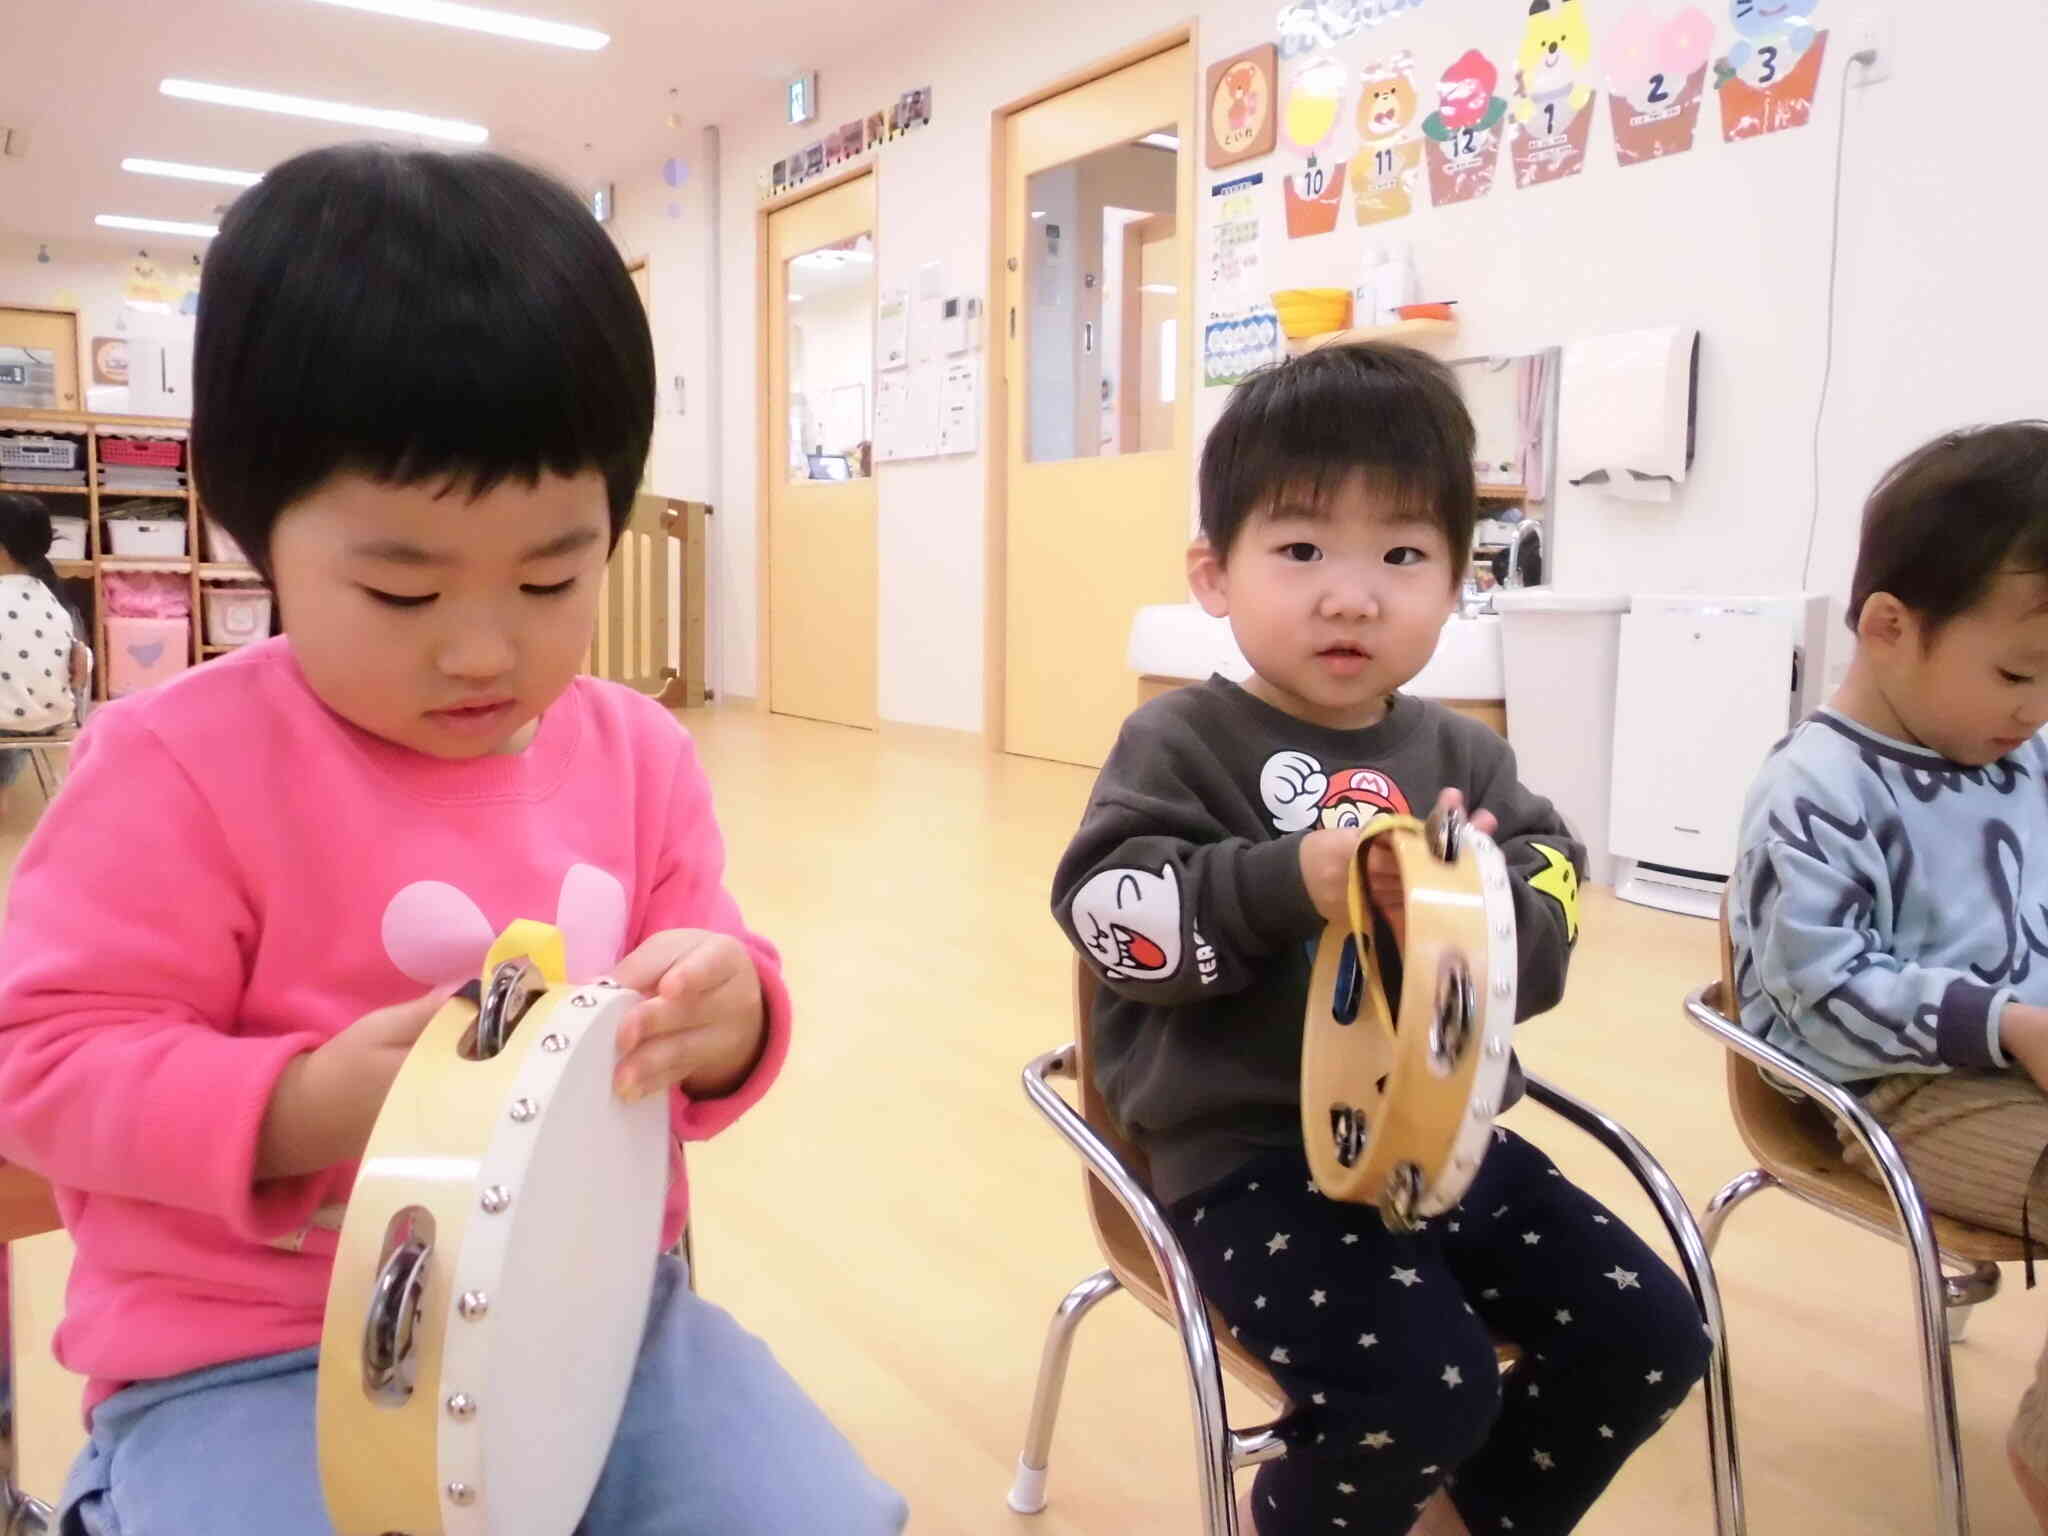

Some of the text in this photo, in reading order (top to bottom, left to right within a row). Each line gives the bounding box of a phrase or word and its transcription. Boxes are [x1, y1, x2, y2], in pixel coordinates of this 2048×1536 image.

[1757, 45, 1778, 84] 3
[1647, 73, 1669, 104] 2
[1543, 102, 1555, 135] 1
[1452, 128, 1477, 158] 12
[1375, 148, 1393, 176] 11
[1304, 168, 1324, 197] 10
[1355, 774, 1383, 794] M
